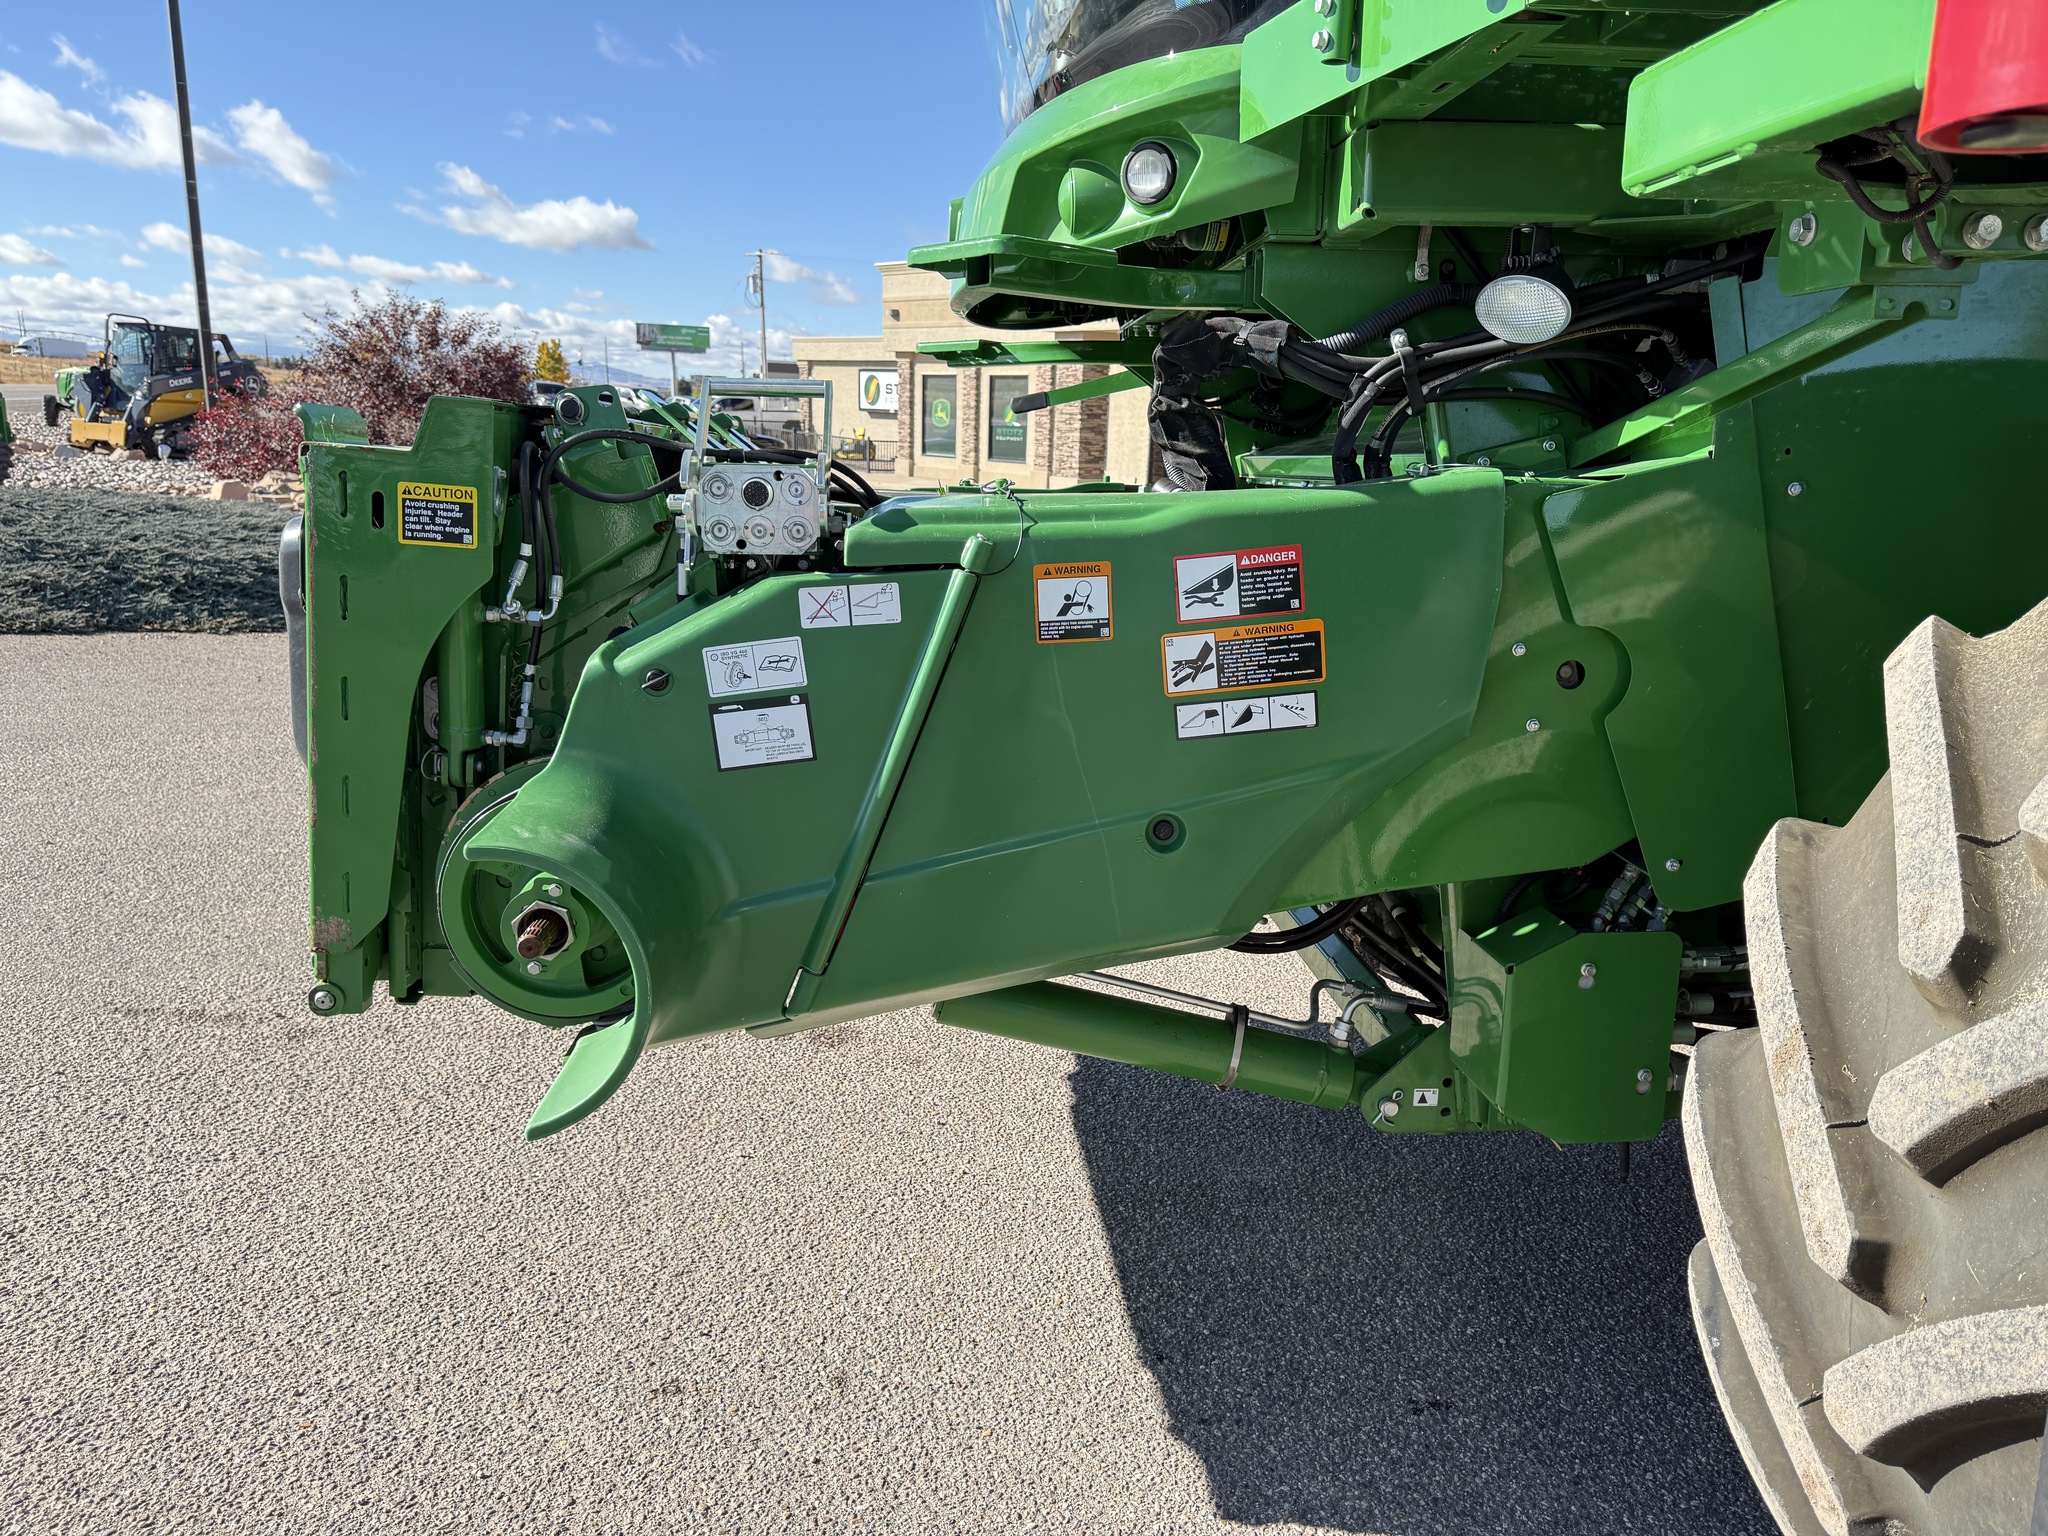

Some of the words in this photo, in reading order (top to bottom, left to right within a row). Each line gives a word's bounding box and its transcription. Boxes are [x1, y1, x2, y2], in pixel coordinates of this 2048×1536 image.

[168, 376, 194, 388] DEERE
[885, 384, 900, 394] ST
[996, 428, 1024, 437] STOTZ
[413, 486, 473, 500] CAUTION
[428, 502, 459, 511] crushing
[435, 517, 451, 526] Stay
[414, 531, 443, 540] running.
[1251, 551, 1296, 564] DANGER
[1054, 565, 1100, 575] WARNING
[1245, 624, 1294, 636] WARNING
